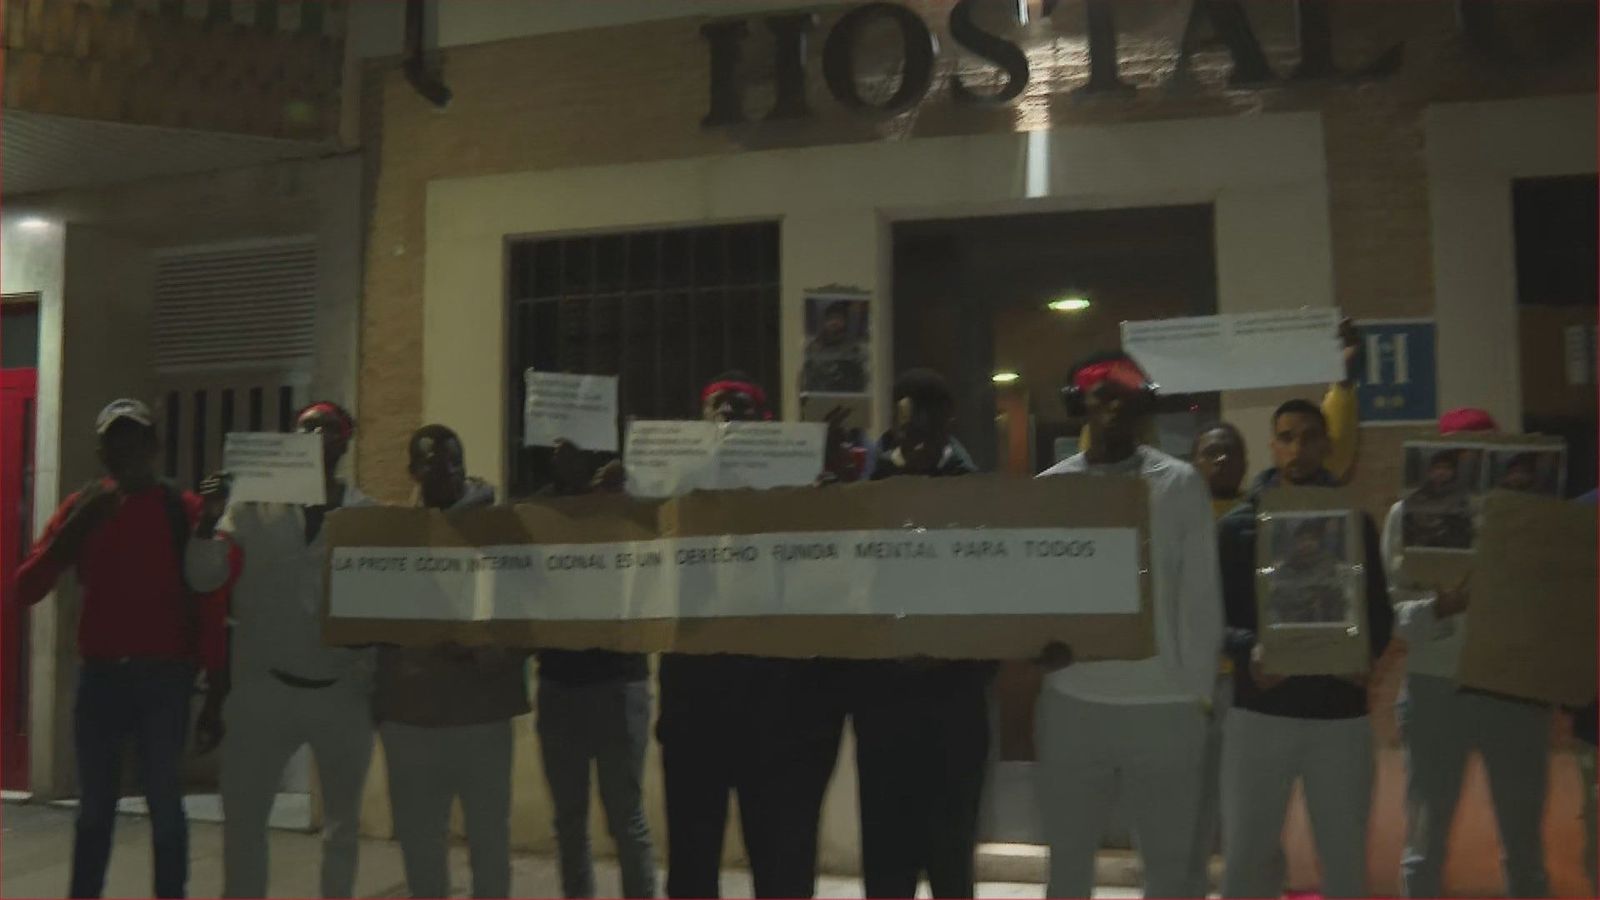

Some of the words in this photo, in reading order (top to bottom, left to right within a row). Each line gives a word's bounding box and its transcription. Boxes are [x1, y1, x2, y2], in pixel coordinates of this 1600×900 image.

[700, 0, 1404, 128] HOSTAL
[334, 556, 353, 572] LA
[358, 555, 408, 572] PROTE
[546, 553, 607, 570] CIONAL
[615, 552, 633, 569] ES
[676, 546, 760, 565] DERECHO
[772, 543, 839, 562] FUNDA
[854, 541, 938, 559] MENTAL
[951, 540, 1009, 559] PARA
[1024, 539, 1097, 559] TODOS
